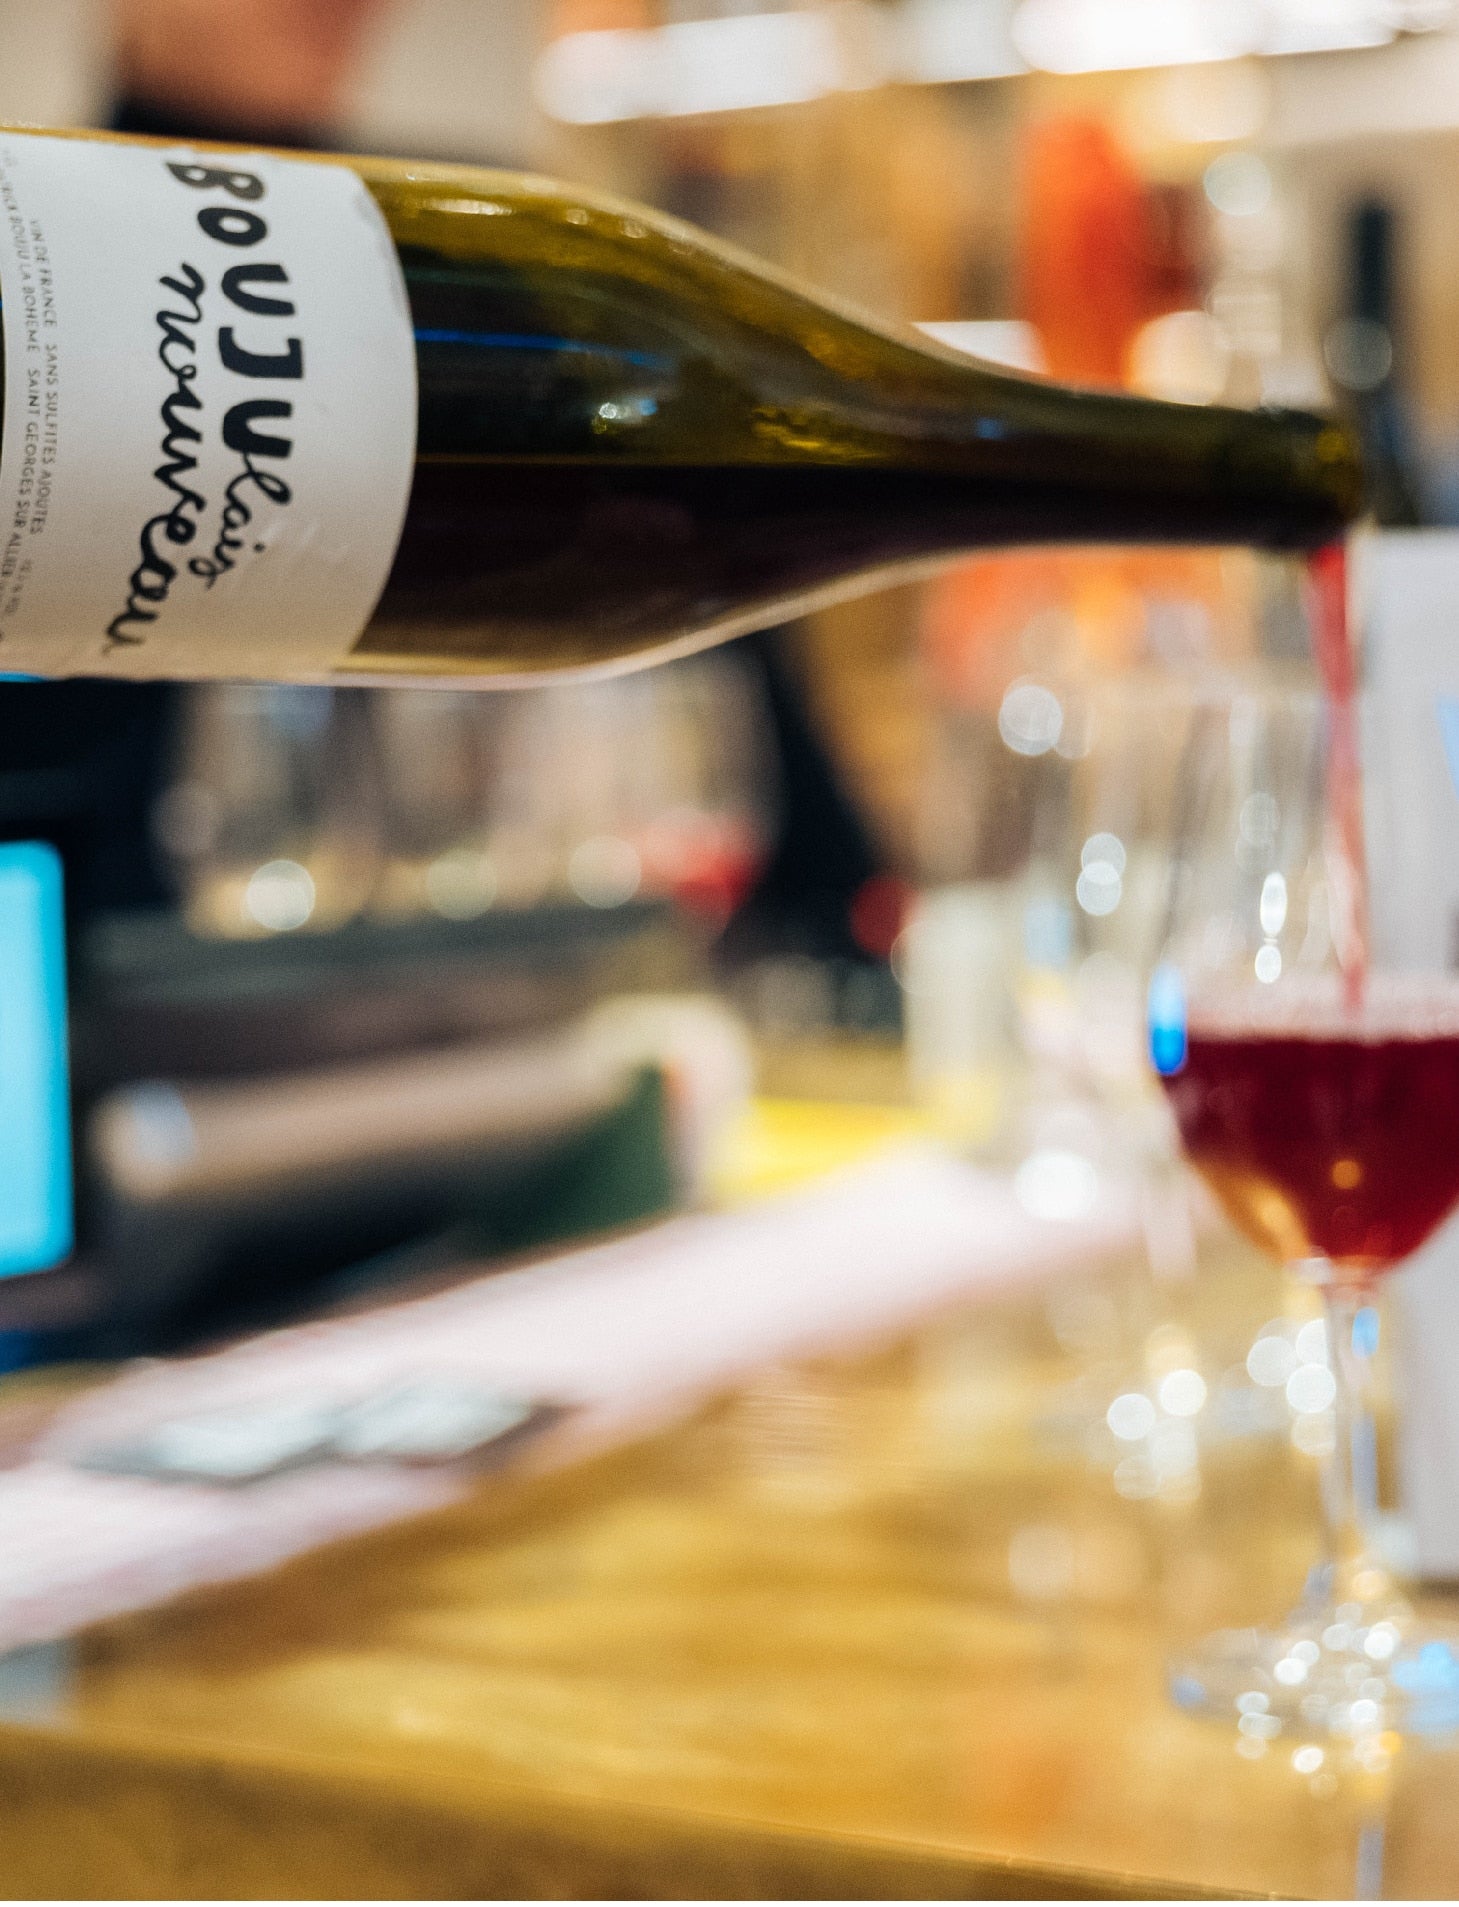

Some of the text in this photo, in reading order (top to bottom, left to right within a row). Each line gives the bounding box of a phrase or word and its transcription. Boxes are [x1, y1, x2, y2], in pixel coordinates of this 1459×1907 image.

[39, 267, 57, 327] FRANCE
[28, 368, 40, 415] SAINT
[46, 344, 58, 386] SANS
[42, 391, 58, 465] SULFITES
[18, 422, 39, 496] GEORGES
[14, 500, 31, 528] SUR
